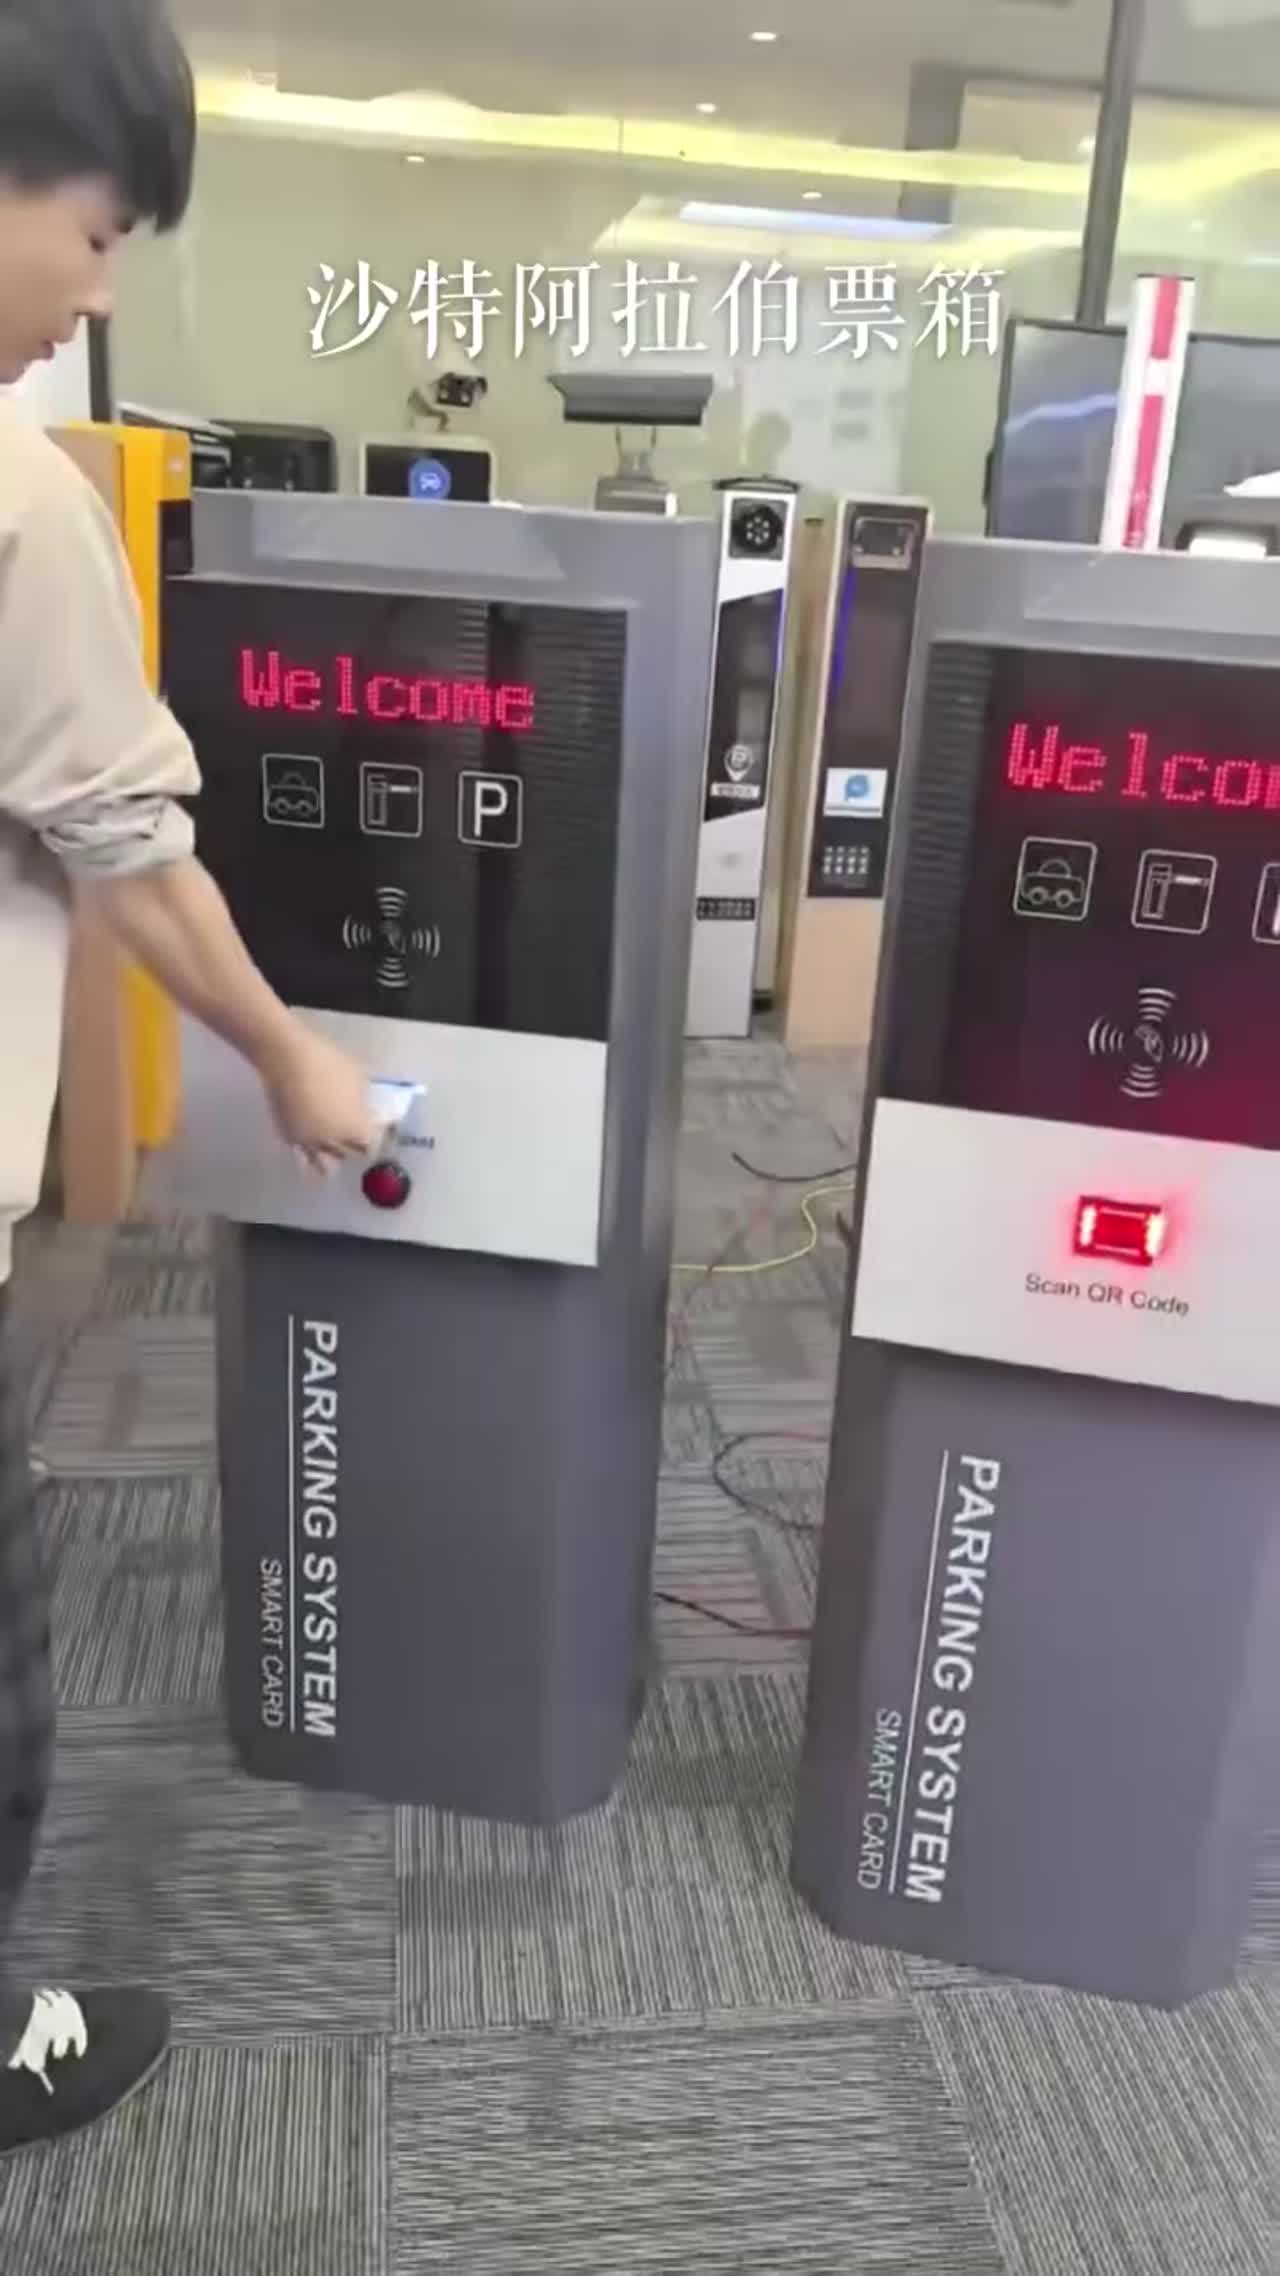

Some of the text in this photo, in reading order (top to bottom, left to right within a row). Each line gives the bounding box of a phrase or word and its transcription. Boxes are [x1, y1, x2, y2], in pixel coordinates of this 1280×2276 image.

[240, 649, 535, 729] Welcome
[473, 781, 507, 838] P
[1025, 1272, 1190, 1317] Scan QR Code
[303, 1320, 338, 1738] PARKING SYSTEM
[259, 1557, 285, 1729] SMART CARD
[904, 1454, 1001, 1903] PARKING SYSTEM
[856, 1709, 903, 1891] SMART CARD
